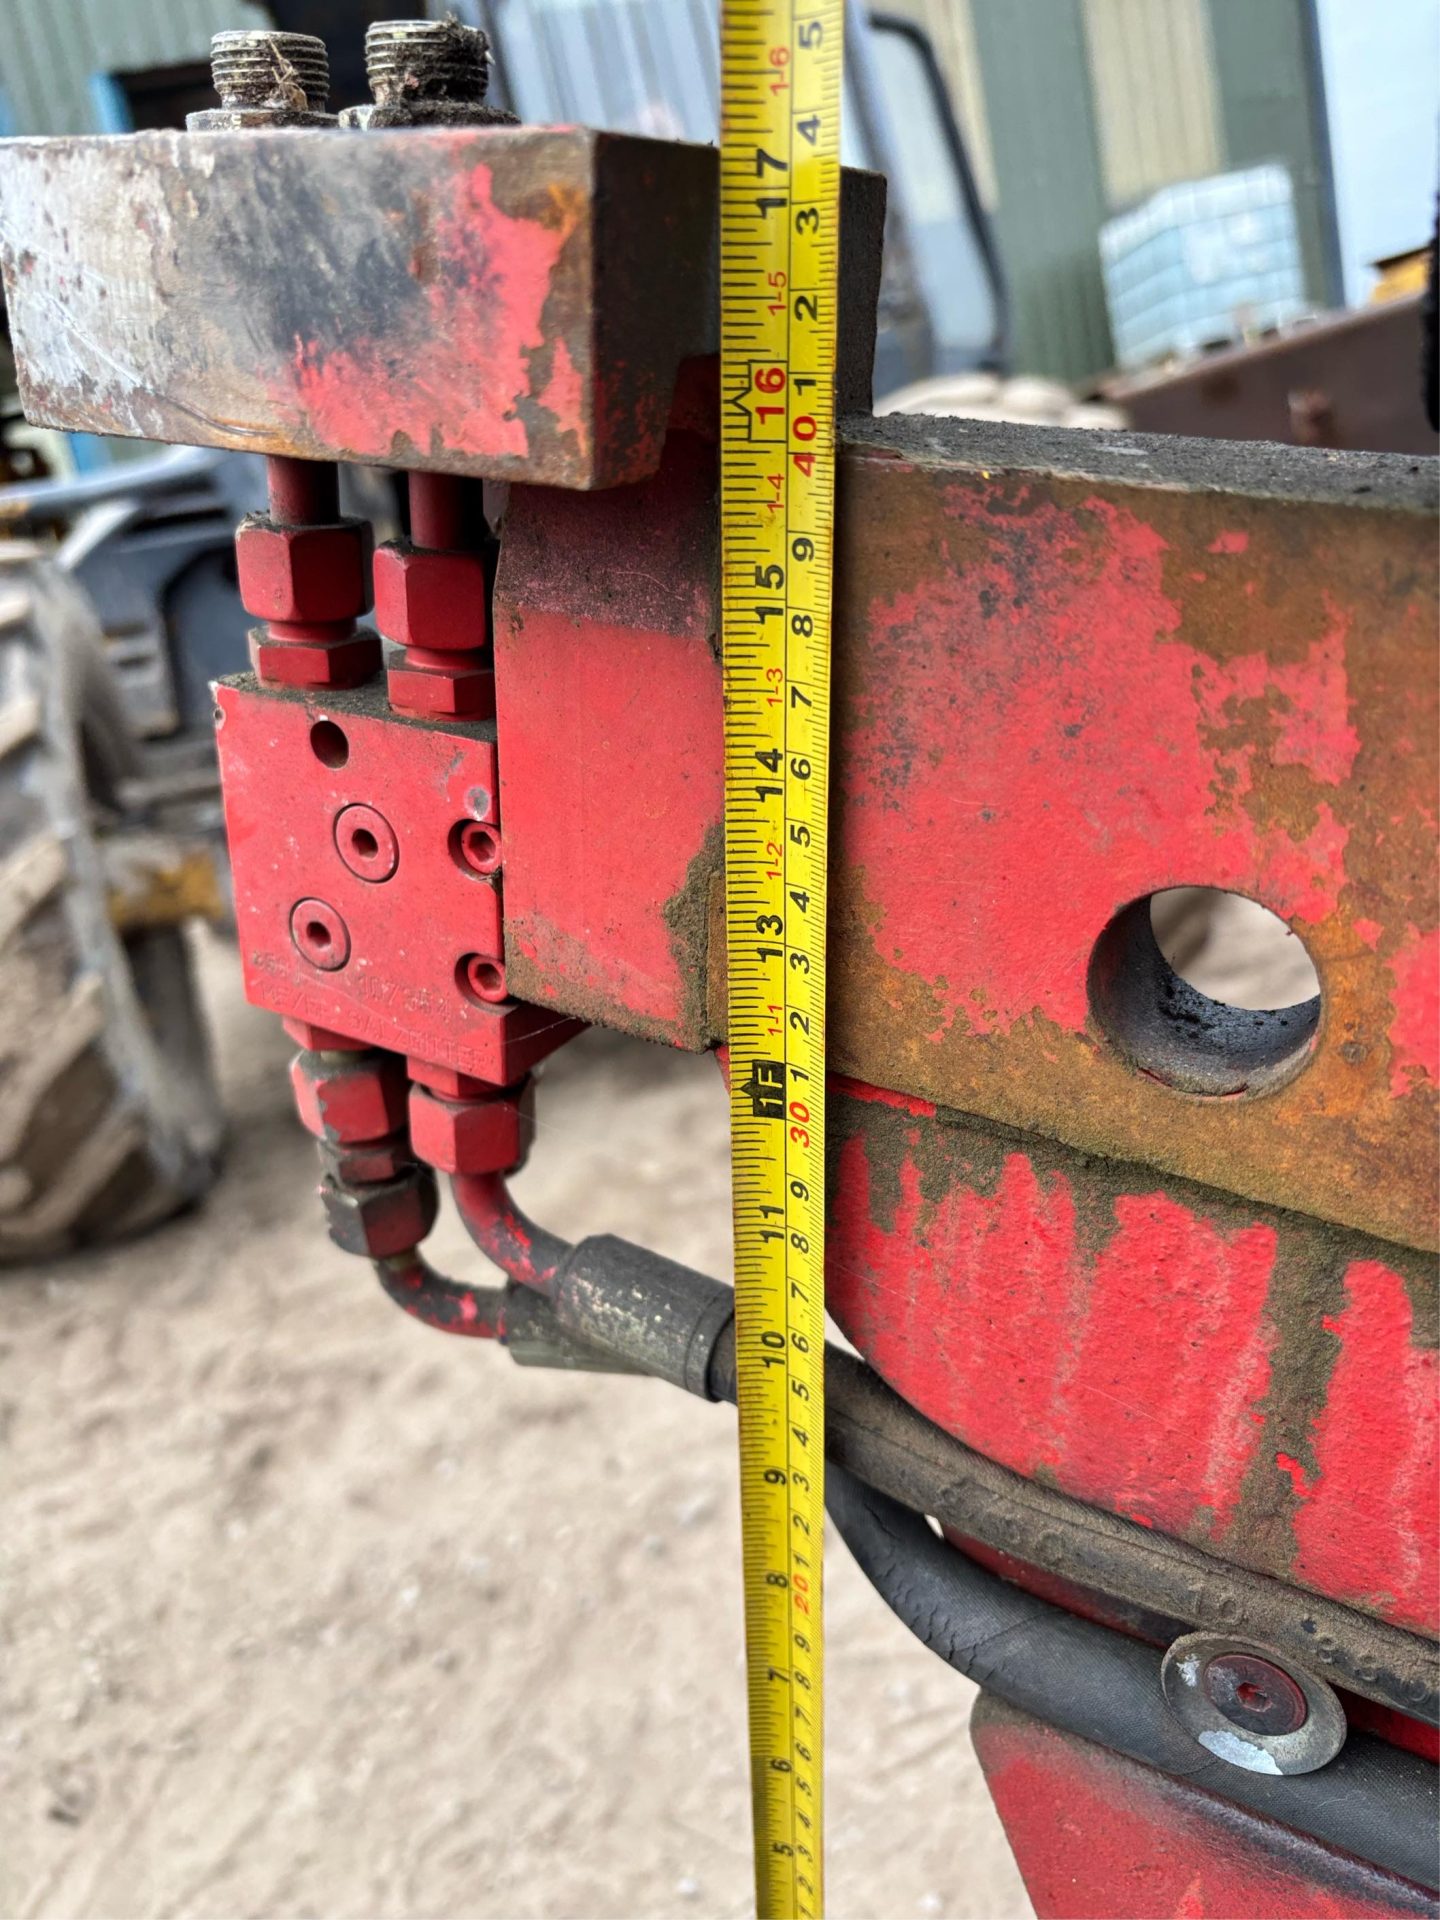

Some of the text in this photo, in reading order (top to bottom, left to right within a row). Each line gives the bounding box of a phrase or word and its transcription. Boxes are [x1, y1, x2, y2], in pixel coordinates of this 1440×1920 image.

[798, 21, 824, 48] 5
[796, 115, 820, 146] 4
[756, 148, 788, 219] 17
[795, 207, 819, 235] 3
[794, 295, 818, 321] 2
[754, 368, 786, 425] 16
[793, 379, 816, 396] 1
[792, 537, 814, 562] 9
[755, 564, 784, 625] 15
[791, 614, 813, 638] 8
[791, 686, 812, 708] 7
[755, 748, 783, 803] 14
[790, 758, 811, 780] 6
[790, 824, 811, 848] 5
[790, 891, 810, 913] 4
[756, 914, 783, 963] 13
[790, 952, 809, 974] 3
[790, 1011, 809, 1036] 2
[790, 1068, 809, 1082] 1
[758, 1067, 783, 1106] 1F
[790, 1181, 809, 1201] 9
[759, 1205, 784, 1243] 11
[790, 1233, 809, 1254] 8
[791, 1282, 809, 1303] 7
[761, 1331, 785, 1369] 10
[791, 1332, 809, 1353] 6
[791, 1380, 809, 1401] 5
[791, 1427, 809, 1447] 4
[763, 1469, 786, 1485] 9
[793, 1472, 809, 1492] 3
[793, 1514, 810, 1536] 2
[793, 1554, 810, 1568] 1
[766, 1573, 788, 1588] 8
[794, 1634, 810, 1653] 9
[767, 1667, 791, 1683] 7
[795, 1671, 811, 1690] 8
